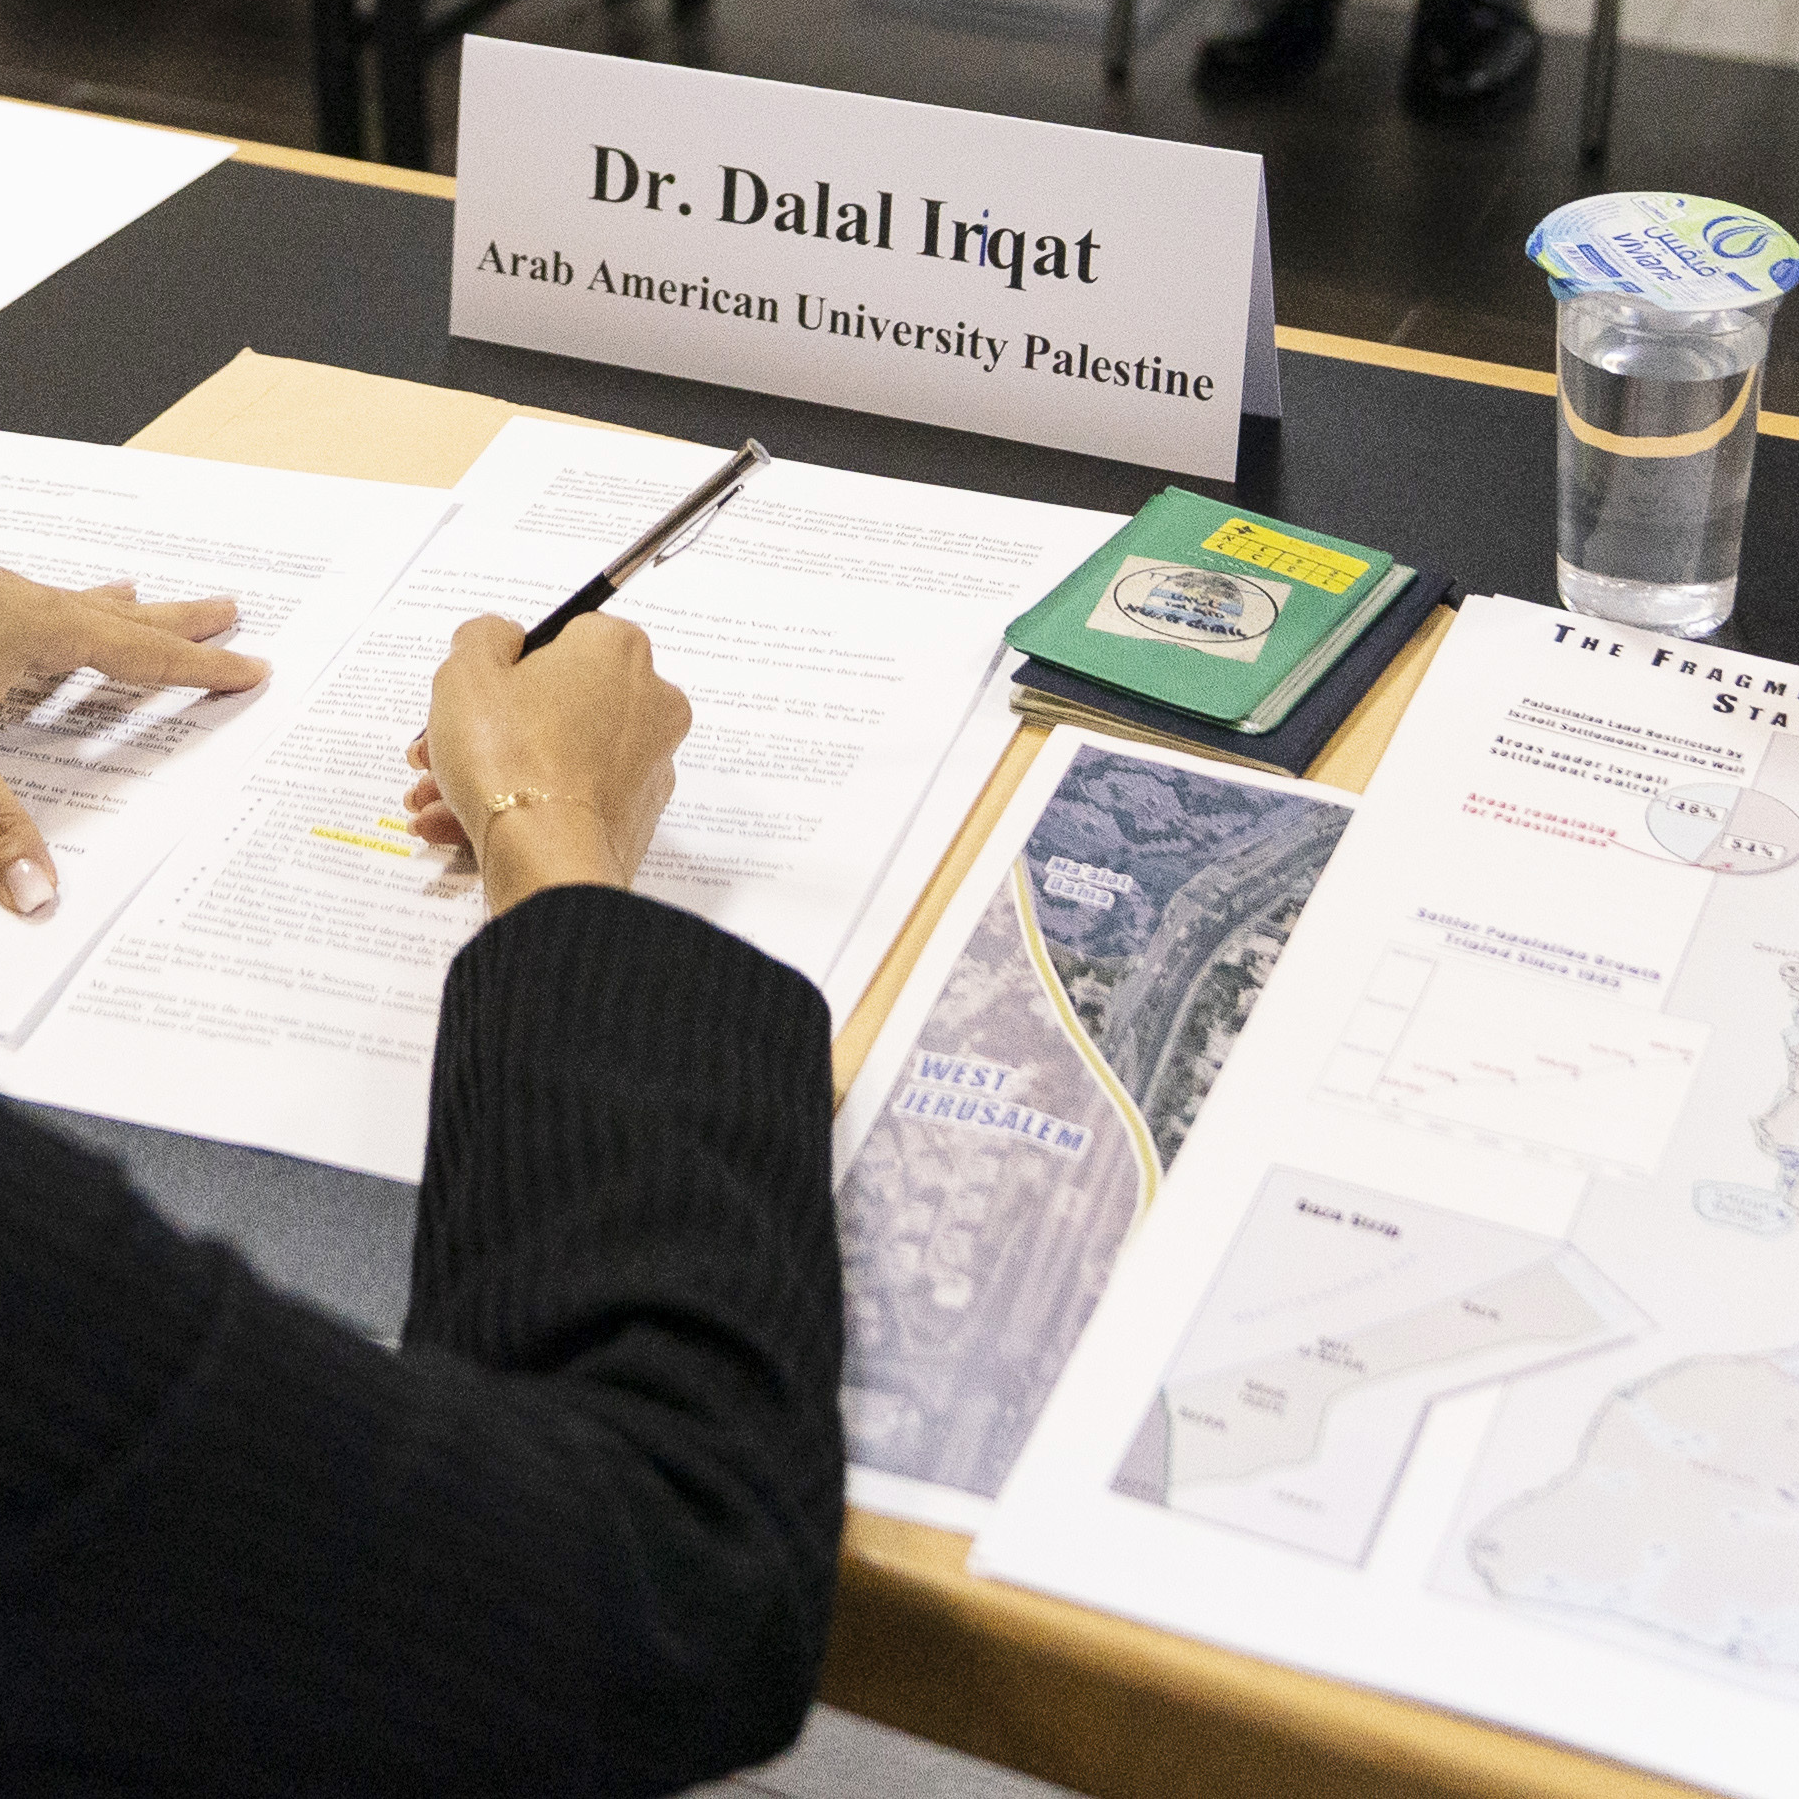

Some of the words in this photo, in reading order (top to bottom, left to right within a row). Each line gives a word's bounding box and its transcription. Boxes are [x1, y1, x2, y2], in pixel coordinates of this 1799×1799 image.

[588, 144, 692, 218] Dr.
[718, 163, 894, 251] Dalal
[477, 239, 576, 288] Arab
[586, 259, 781, 325] American
[796, 291, 1009, 374] University
[1022, 334, 1216, 404] Palestine
[1552, 622, 1625, 659] THE
[1508, 708, 1557, 730] Israeli
[1560, 721, 1649, 752] Settlements
[1652, 744, 1679, 759] and
[1522, 696, 1604, 724] Palestinian
[1608, 718, 1643, 734] Land
[1494, 734, 1545, 759] Areas
[1607, 763, 1670, 786] Israeli
[1591, 772, 1661, 797] control
[918, 1055, 1010, 1094] WEST
[899, 1087, 1086, 1151] JERUSALEM
